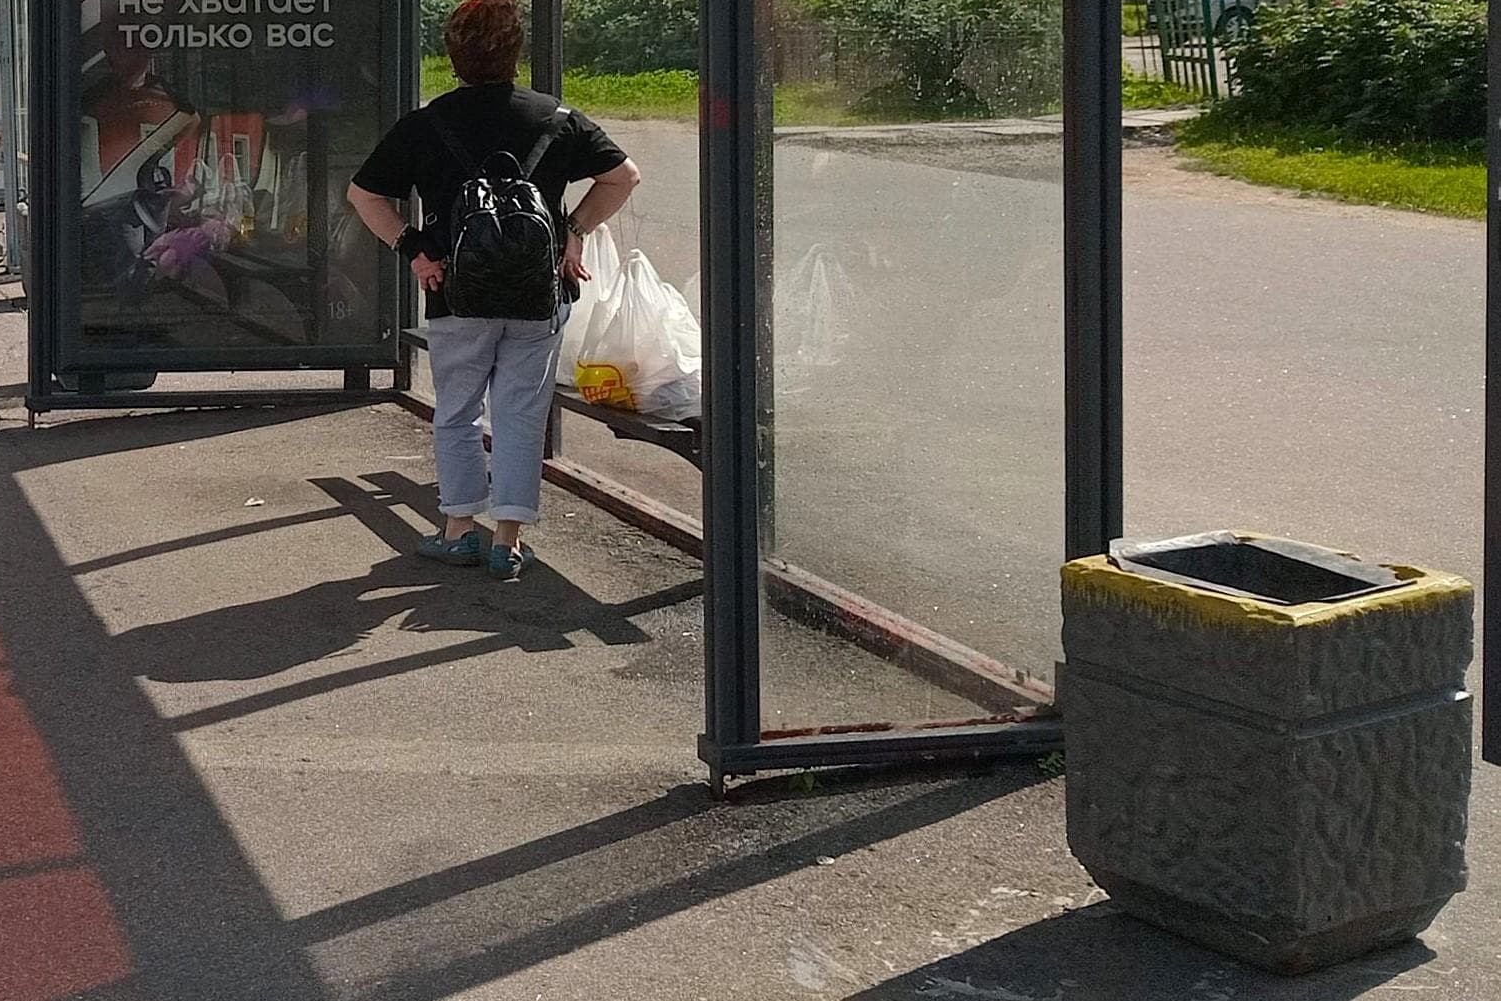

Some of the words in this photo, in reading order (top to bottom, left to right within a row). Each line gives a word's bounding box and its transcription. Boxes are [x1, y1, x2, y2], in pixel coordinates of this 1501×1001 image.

[118, 22, 253, 49] только
[266, 22, 336, 48] вас
[328, 301, 355, 320] 18+
